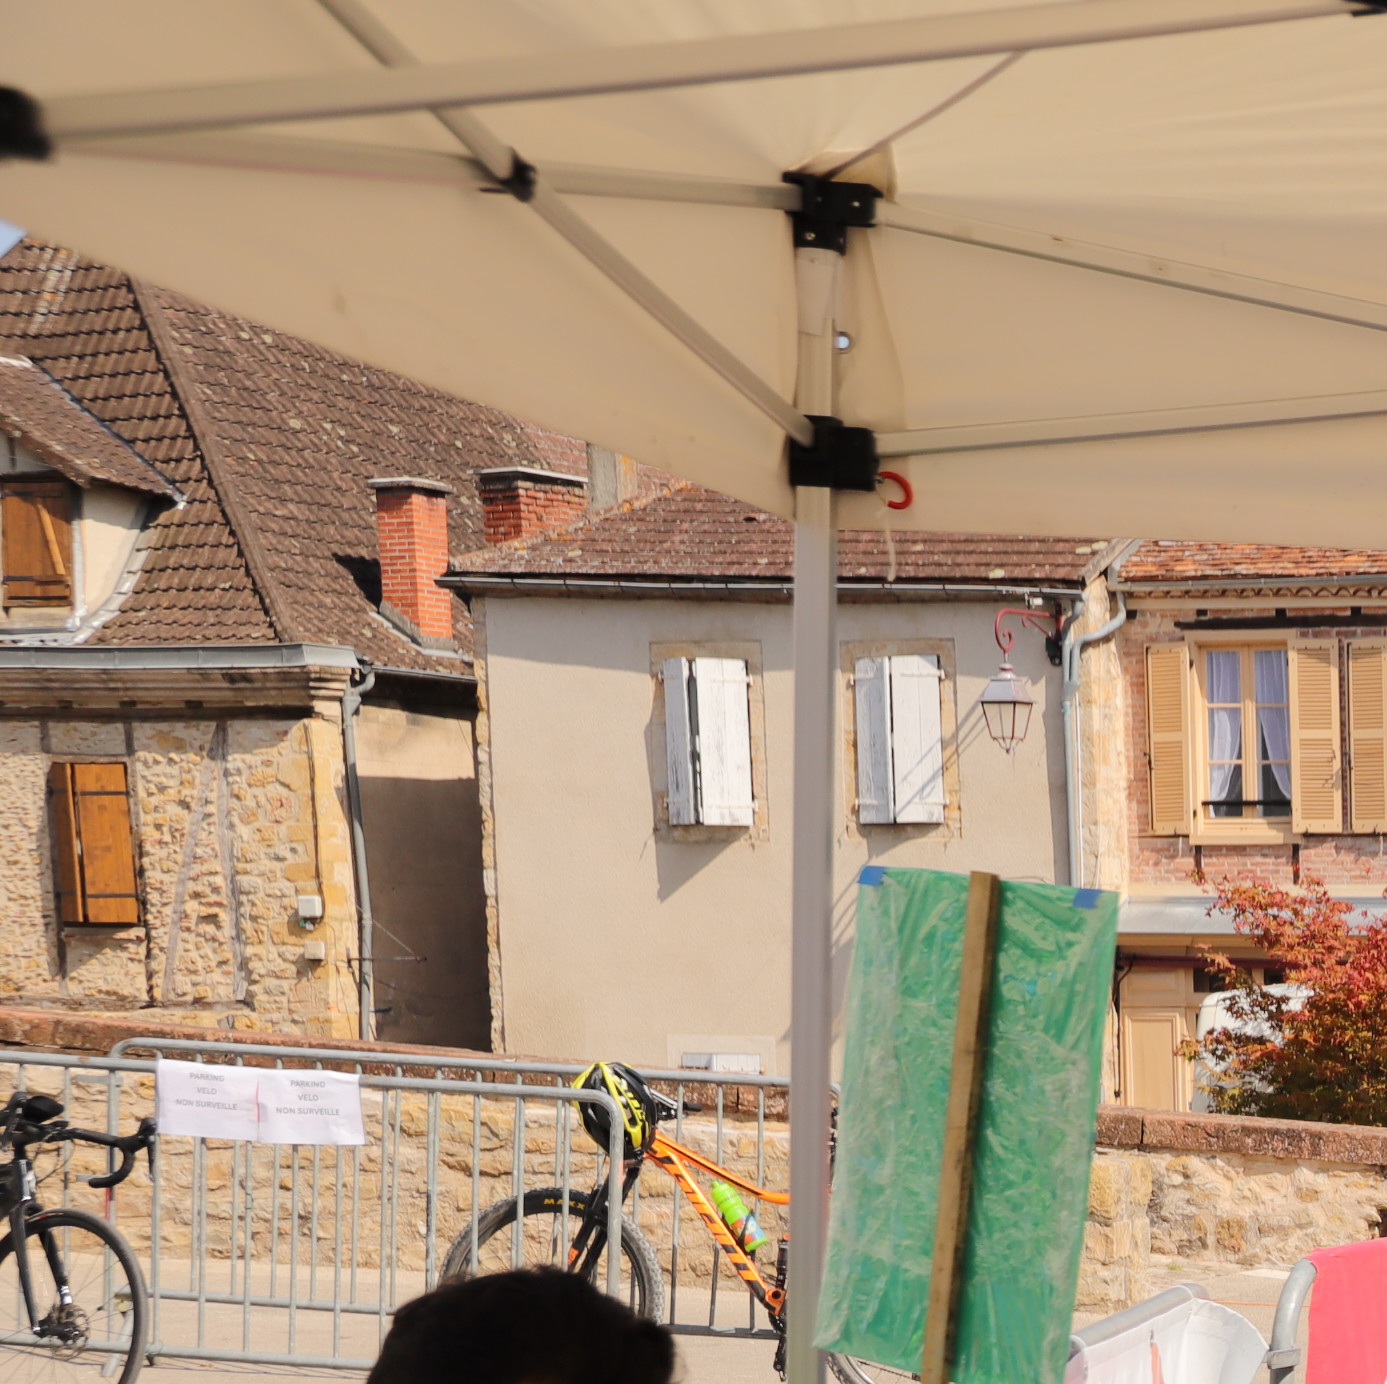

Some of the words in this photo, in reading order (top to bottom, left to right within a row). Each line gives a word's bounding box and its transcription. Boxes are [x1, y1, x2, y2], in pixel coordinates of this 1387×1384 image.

[189, 1072, 225, 1082] PARKING
[290, 1080, 325, 1088] PARKING
[197, 1087, 217, 1095] VELO
[298, 1094, 318, 1102] VELO
[176, 1099, 194, 1107] NON
[195, 1101, 238, 1111] SURVEILLE
[276, 1107, 296, 1115] NON
[297, 1107, 340, 1116] SURVEILLE
[543, 1198, 586, 1210] MAXX
